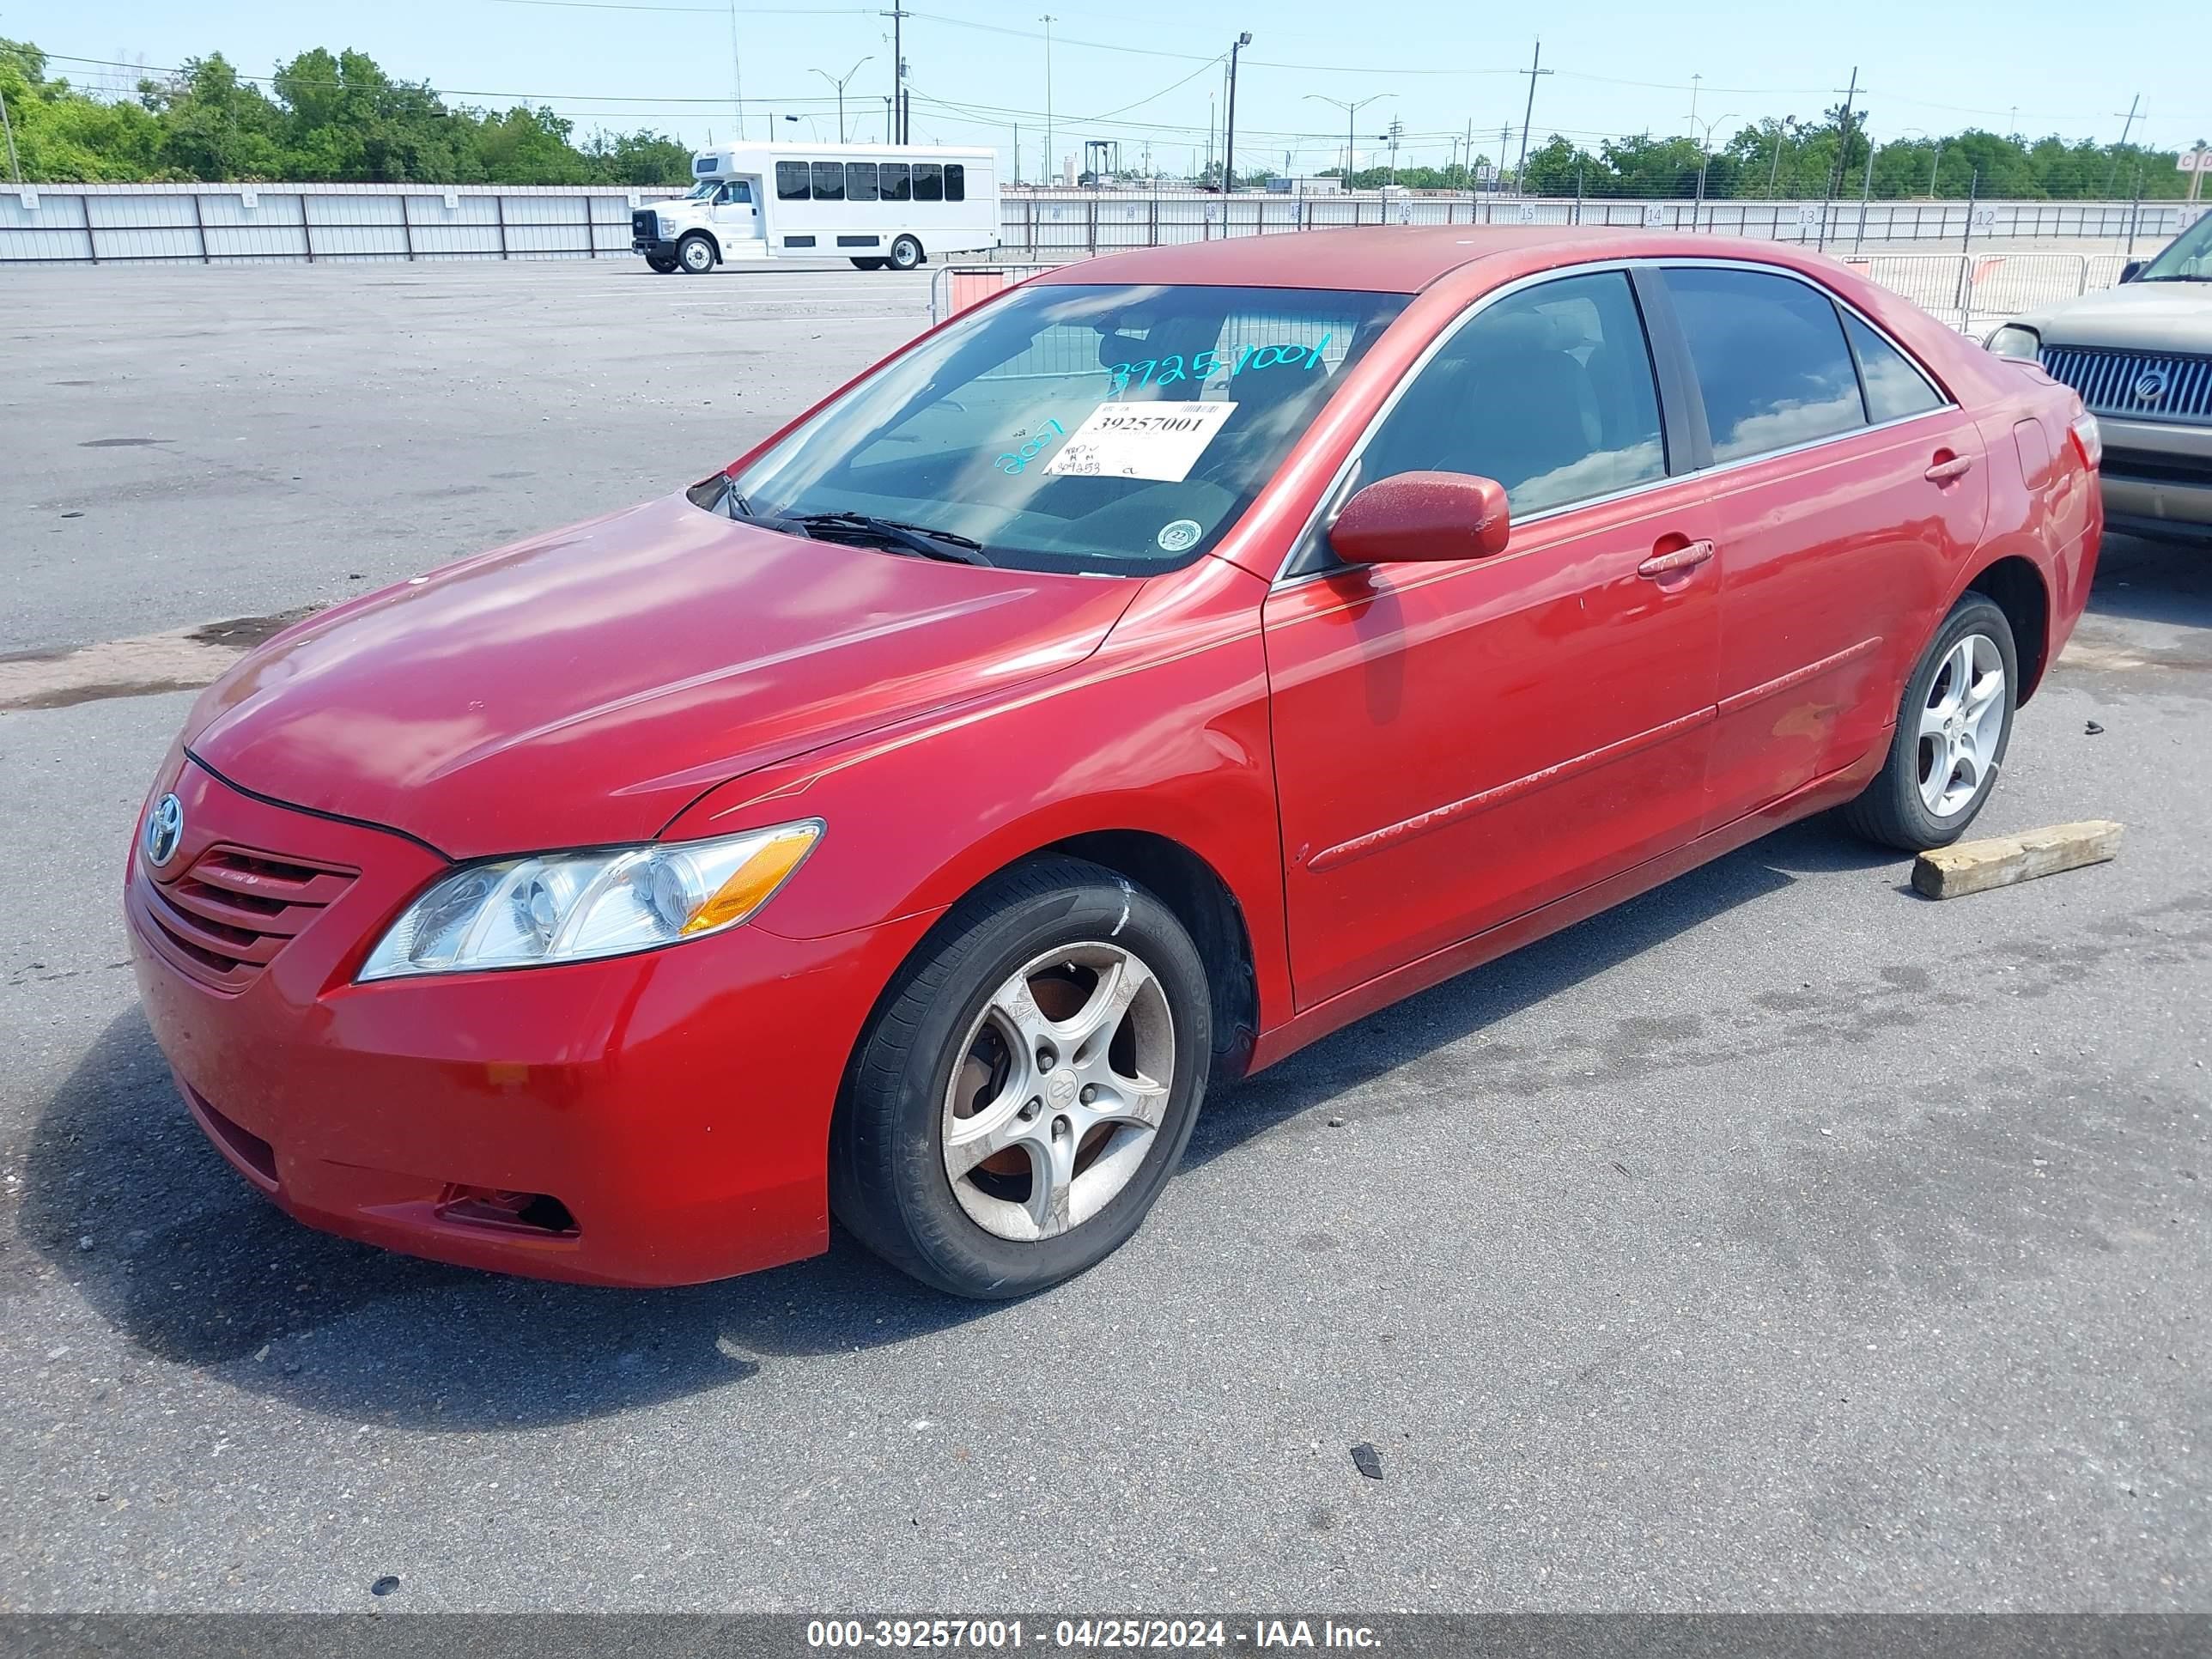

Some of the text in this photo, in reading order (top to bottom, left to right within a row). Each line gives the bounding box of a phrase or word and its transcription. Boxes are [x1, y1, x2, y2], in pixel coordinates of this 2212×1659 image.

[2182, 155, 2192, 167] C
[1478, 167, 1486, 178] A
[1490, 167, 1498, 178] B
[1400, 205, 1411, 217] 16
[1521, 208, 1534, 221] 15
[1647, 209, 1662, 222] 14
[1799, 210, 1815, 224] 13
[1975, 211, 1995, 226] 12
[1106, 332, 1331, 397] 39257001
[1093, 417, 1204, 431] 39257001
[994, 418, 1065, 476] 2007
[1170, 531, 1187, 541] 22
